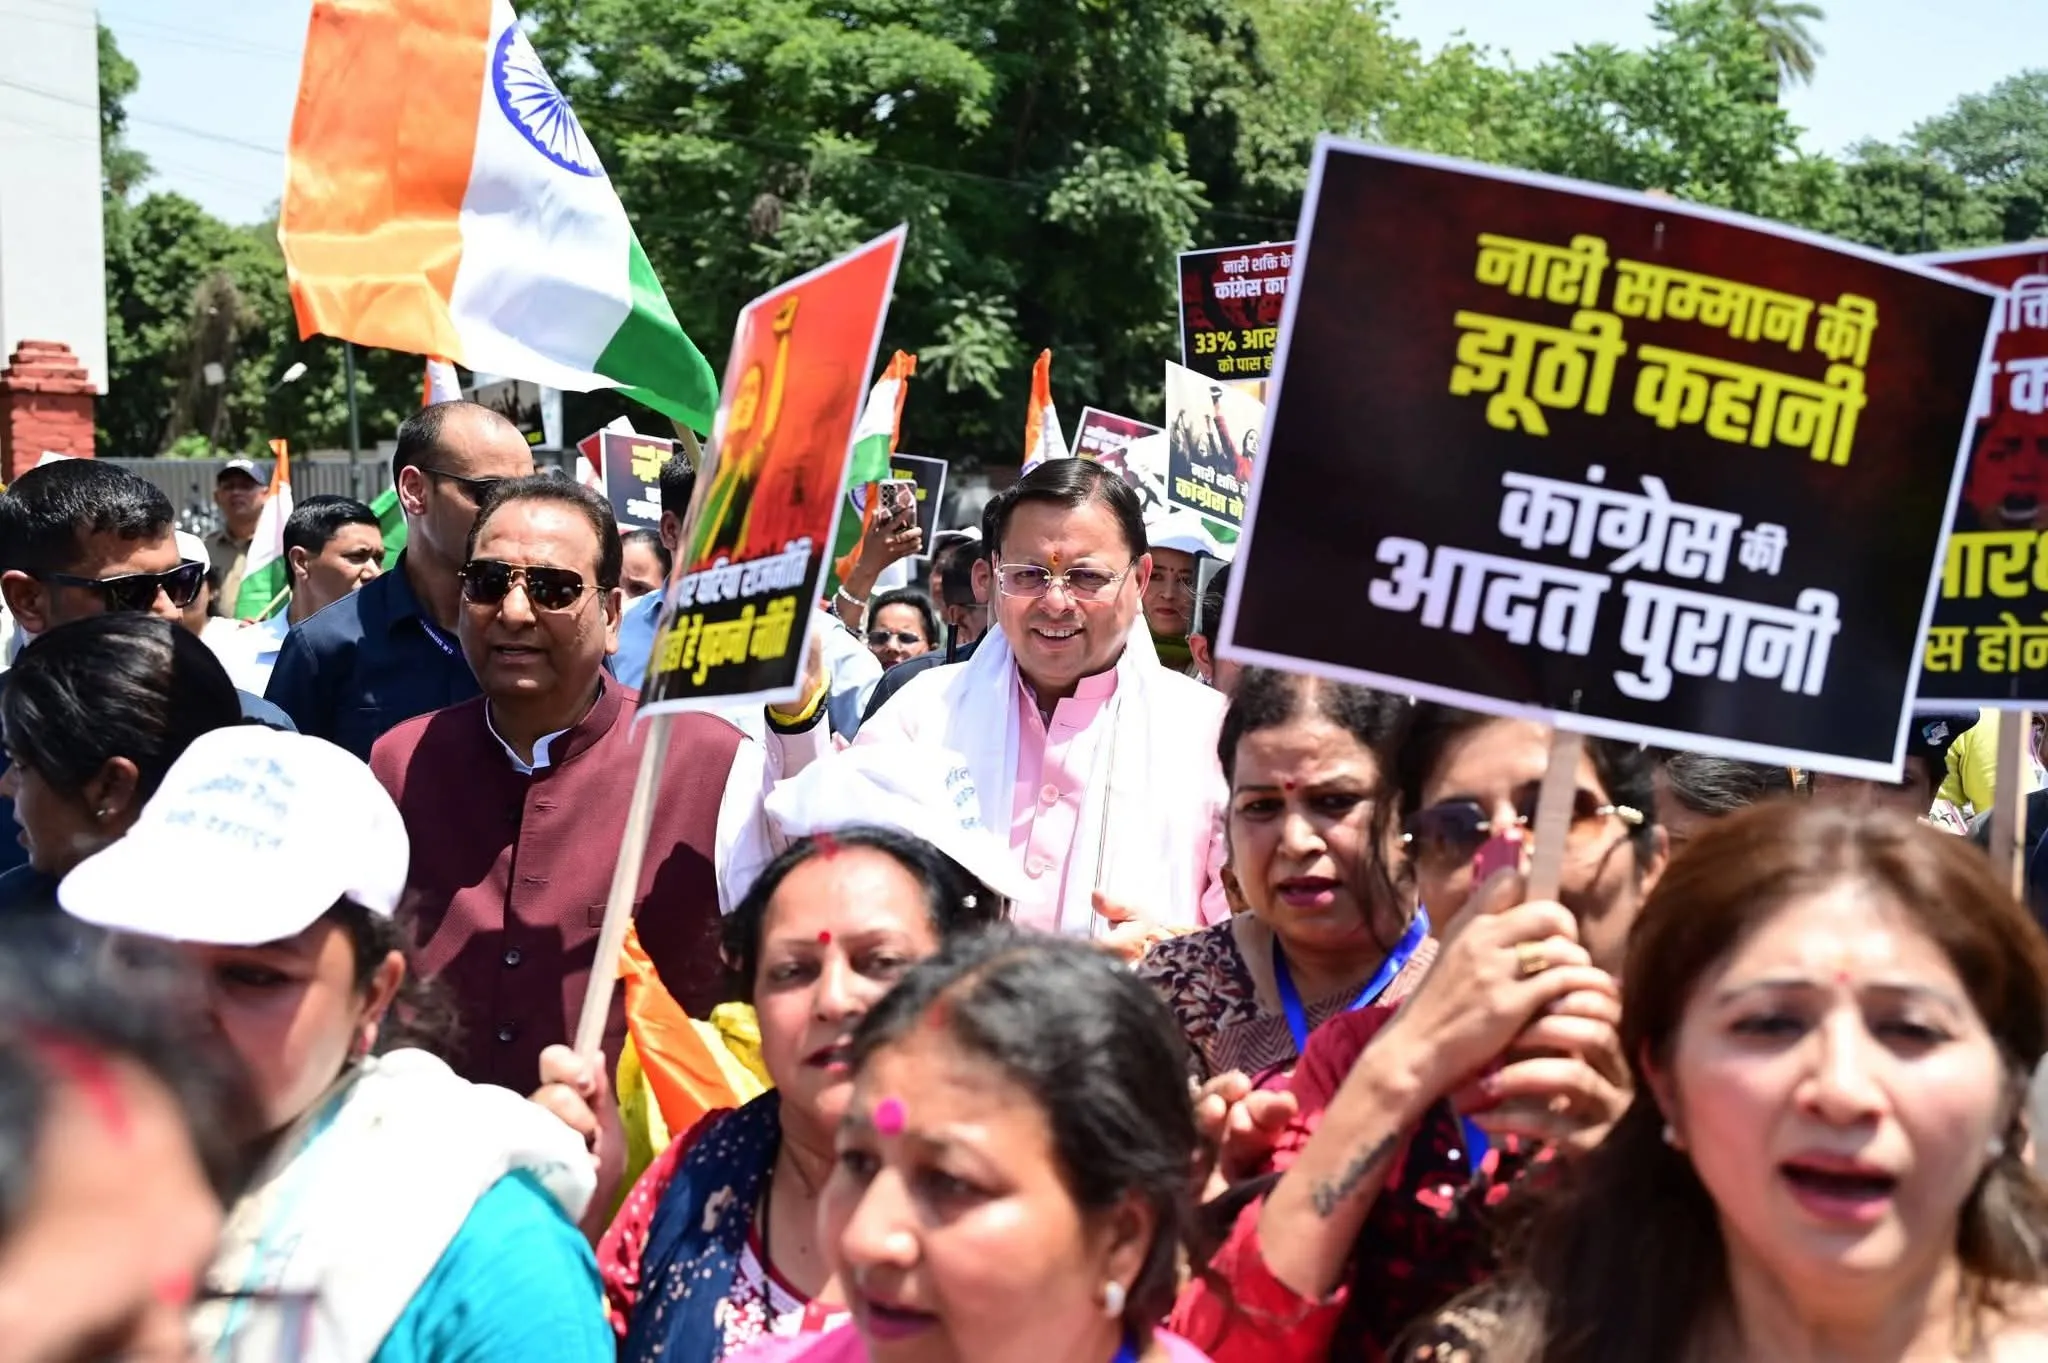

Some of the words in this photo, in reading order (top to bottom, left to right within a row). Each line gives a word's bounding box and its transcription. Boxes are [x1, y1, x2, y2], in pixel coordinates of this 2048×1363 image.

[1222, 255, 1249, 274] नारी
[1252, 253, 1278, 271] शक्ति
[1213, 275, 1262, 299] कांग्रेस
[1475, 233, 1608, 309] नारी
[1612, 258, 1814, 353] सम्मान
[1814, 293, 1879, 368] की
[1194, 331, 1237, 354] 33%
[1217, 355, 1235, 373] को
[1236, 356, 1261, 372] पास
[1449, 309, 1628, 436] झूठी
[1633, 343, 1868, 467] कहानी
[1175, 477, 1228, 514] कांग्रेस
[1498, 465, 1741, 584] कांग्रेस
[1739, 523, 1789, 575] की
[1368, 535, 1610, 656] आदत
[1613, 579, 1841, 702] पुरानी
